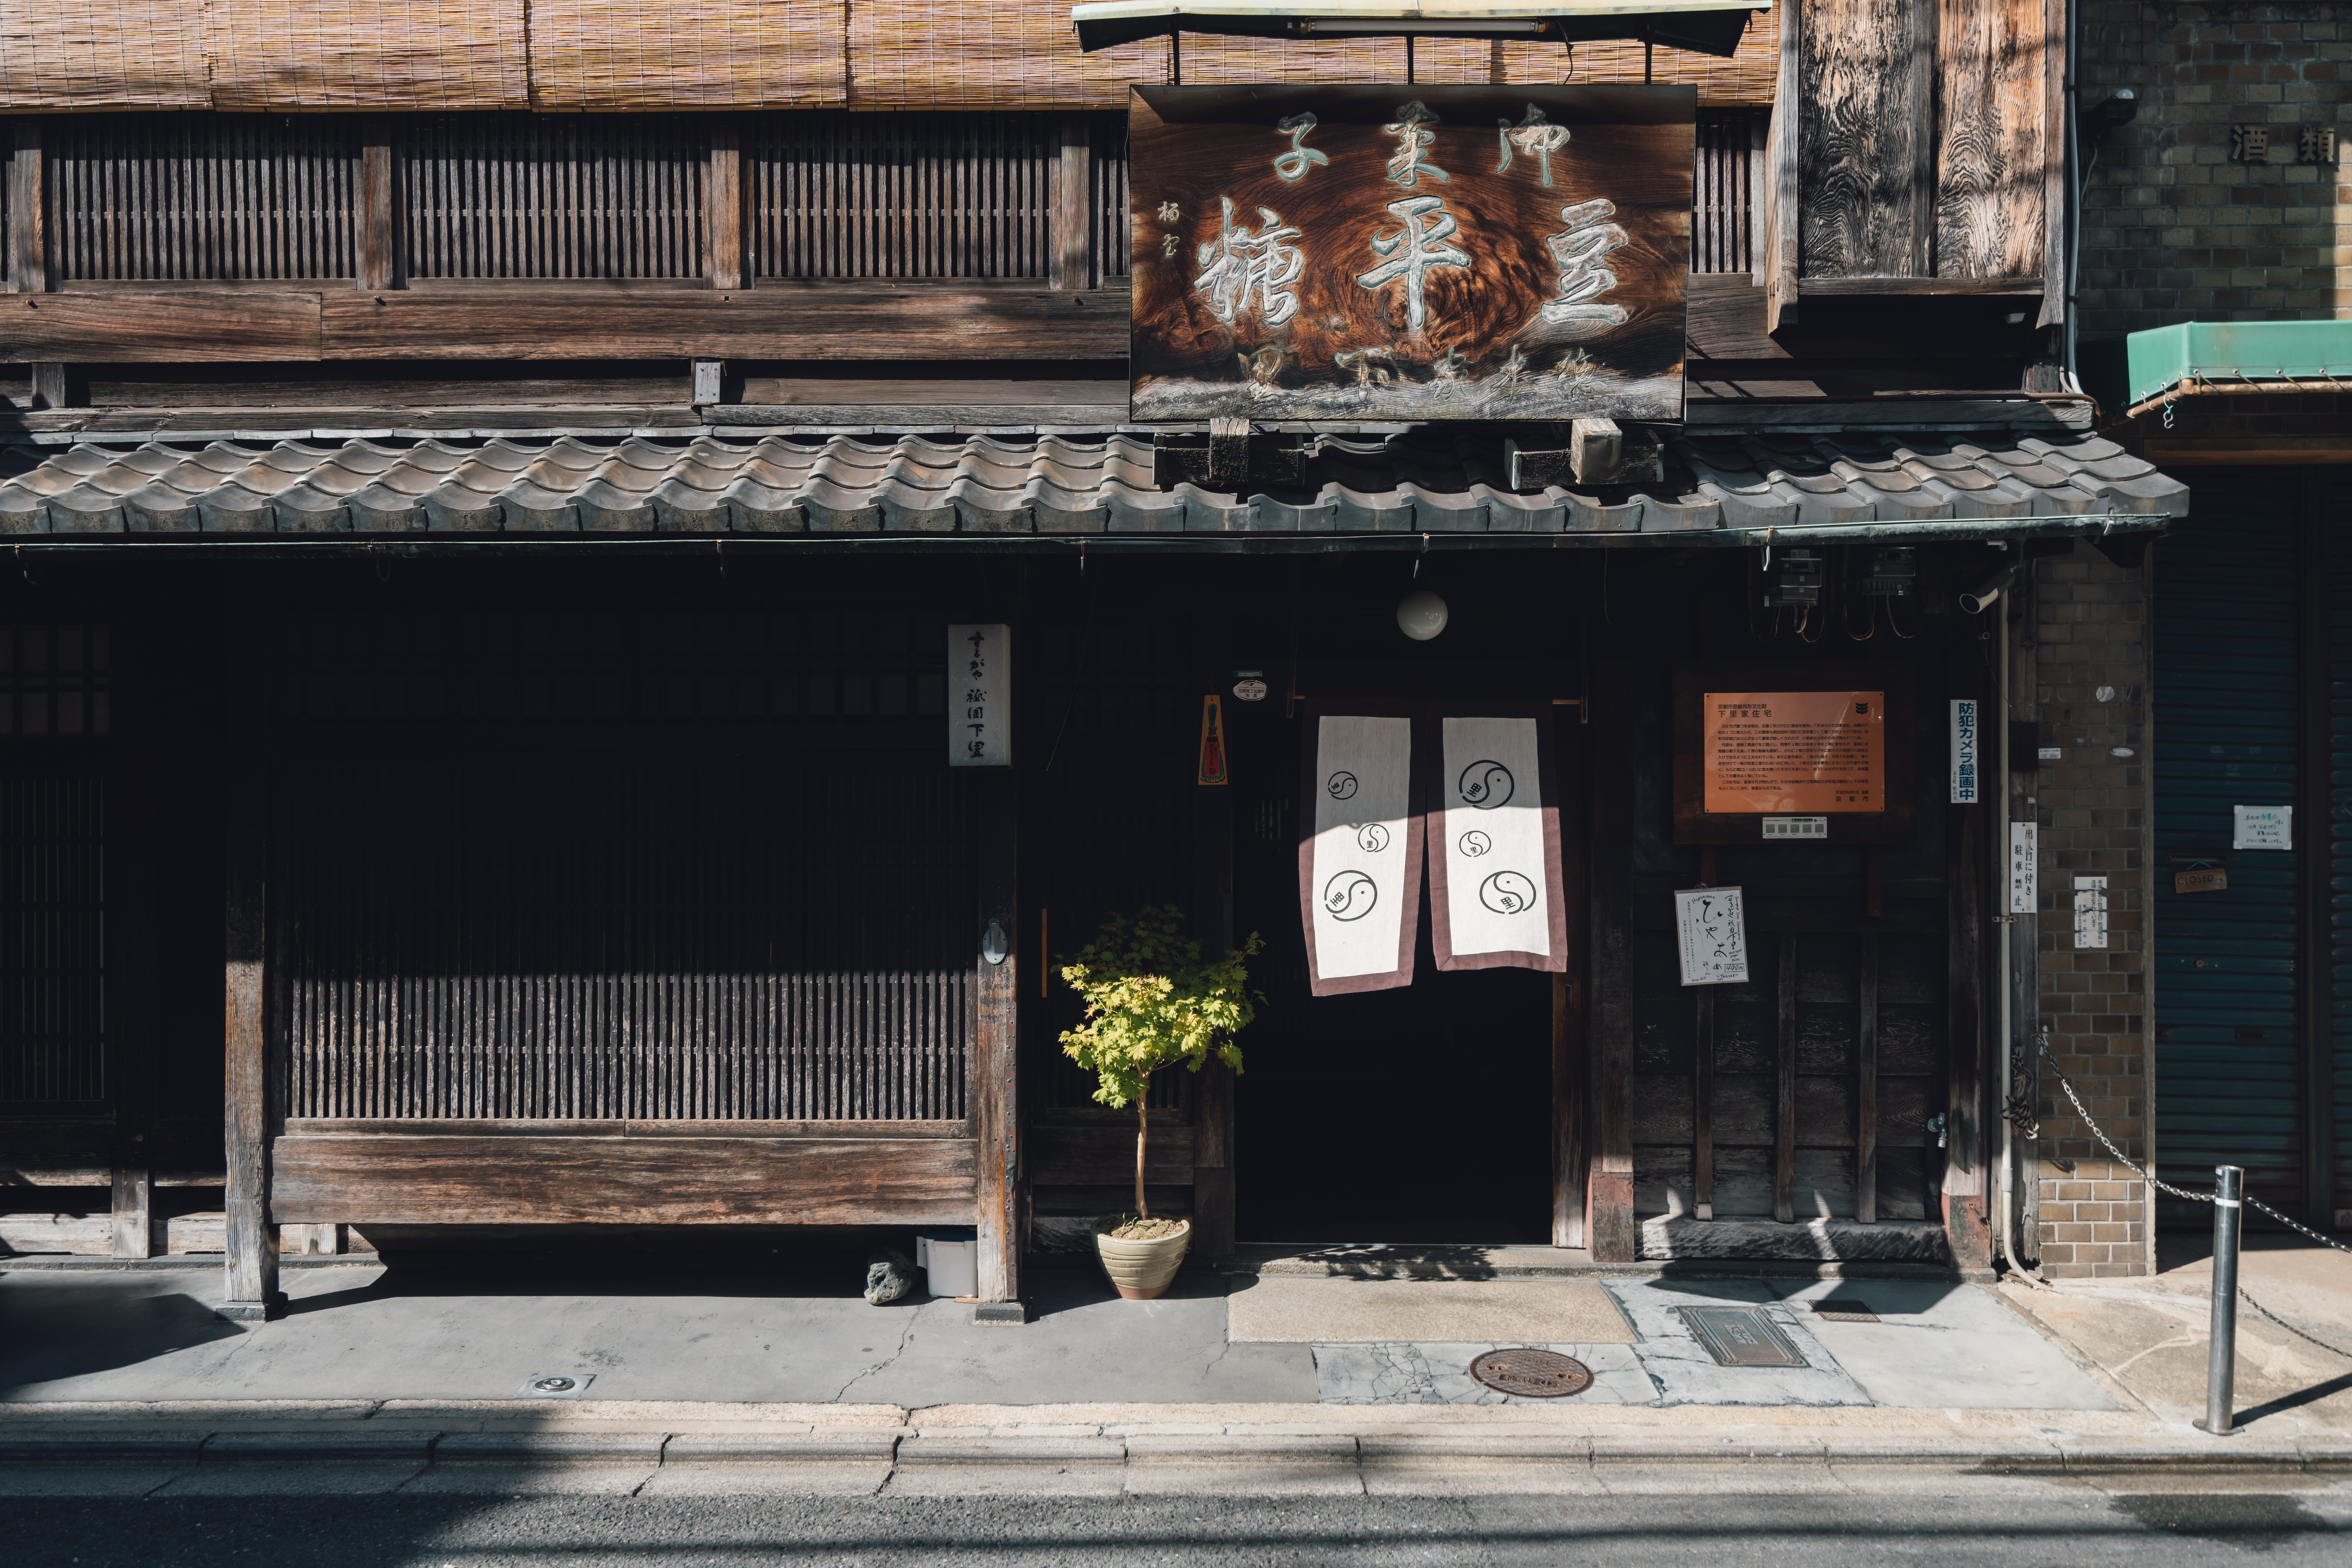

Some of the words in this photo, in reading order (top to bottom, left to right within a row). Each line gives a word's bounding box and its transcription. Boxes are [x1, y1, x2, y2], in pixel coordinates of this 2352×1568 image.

[2232, 124, 2335, 162] 酒類
[967, 631, 985, 681] するがや
[1958, 702, 1975, 800] 防犯カメラ録画中
[1331, 782, 1340, 790] 里
[1466, 782, 1483, 798] 里
[1367, 840, 1374, 849] 里
[1470, 846, 1478, 855] 里
[2014, 845, 2023, 906] 駐車禁止
[2177, 874, 2214, 885] CLOSED
[1330, 891, 1345, 907] 里
[1501, 896, 1516, 909] 里
